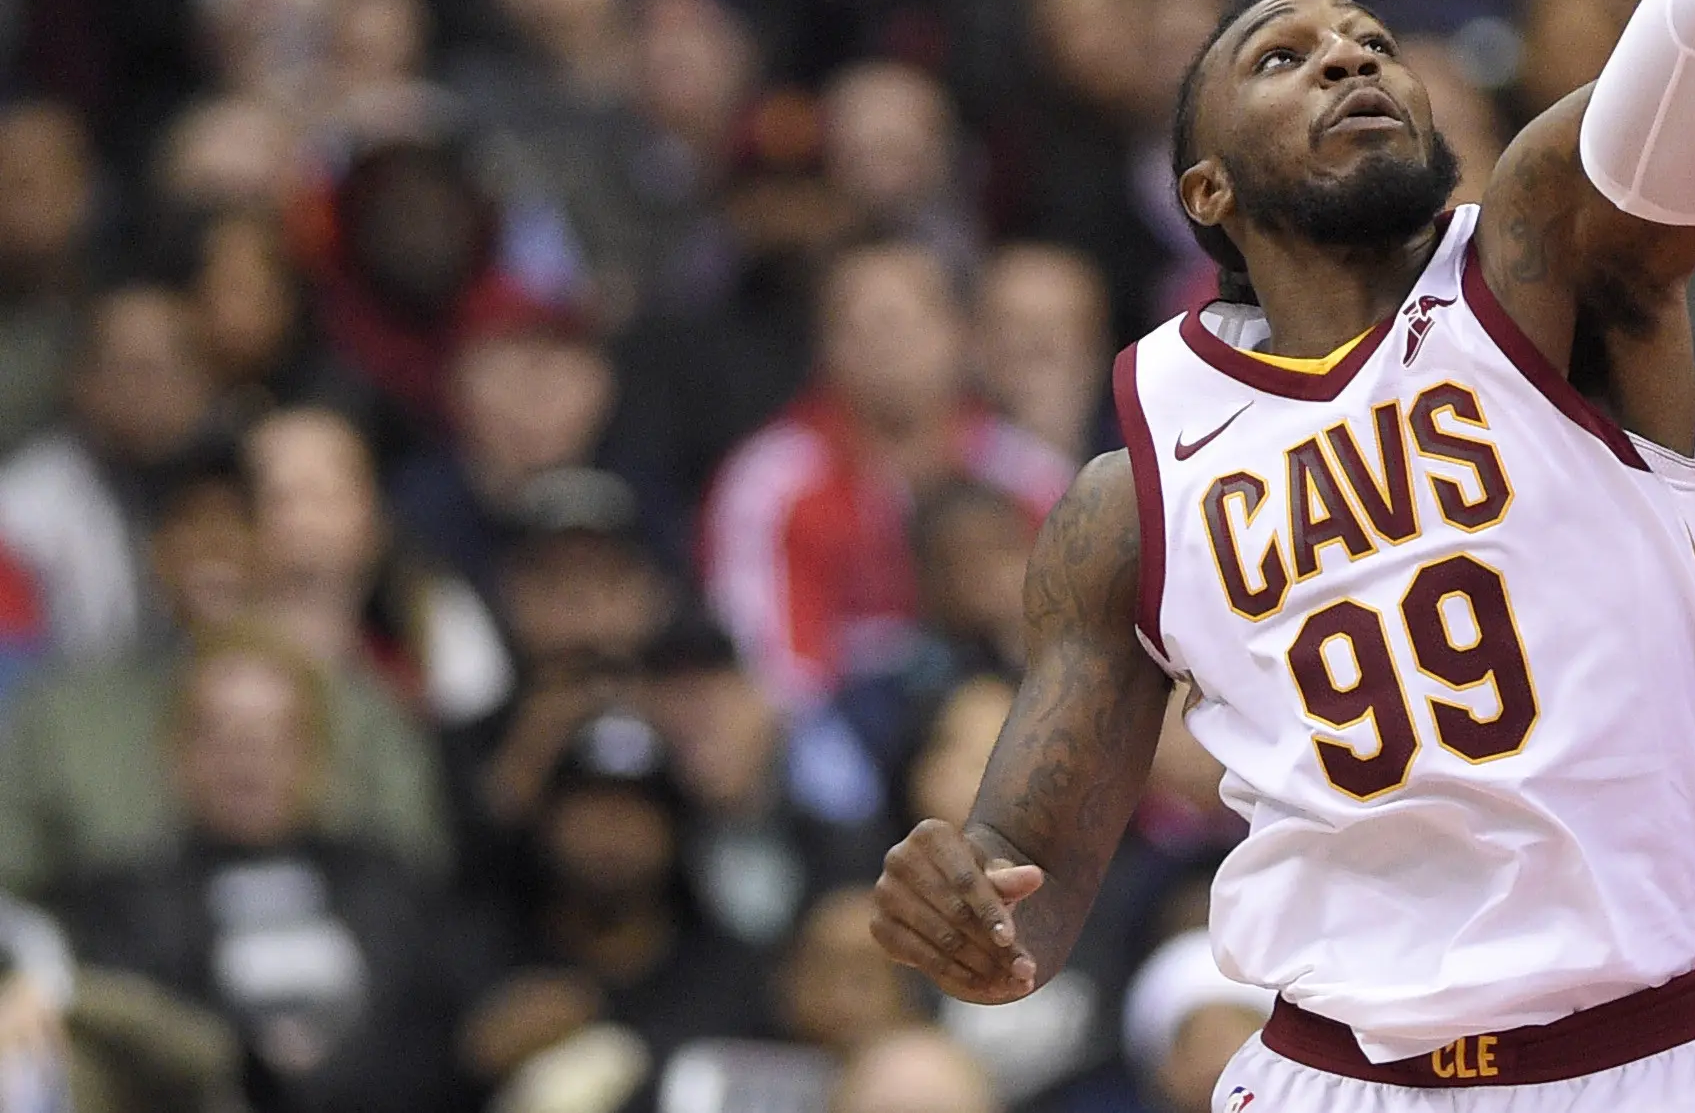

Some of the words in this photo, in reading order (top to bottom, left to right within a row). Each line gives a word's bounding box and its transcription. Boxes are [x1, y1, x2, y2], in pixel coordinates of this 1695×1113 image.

[1200, 380, 1515, 623] CAVS
[1285, 551, 1542, 803] 99
[1432, 1035, 1499, 1079] CLE
